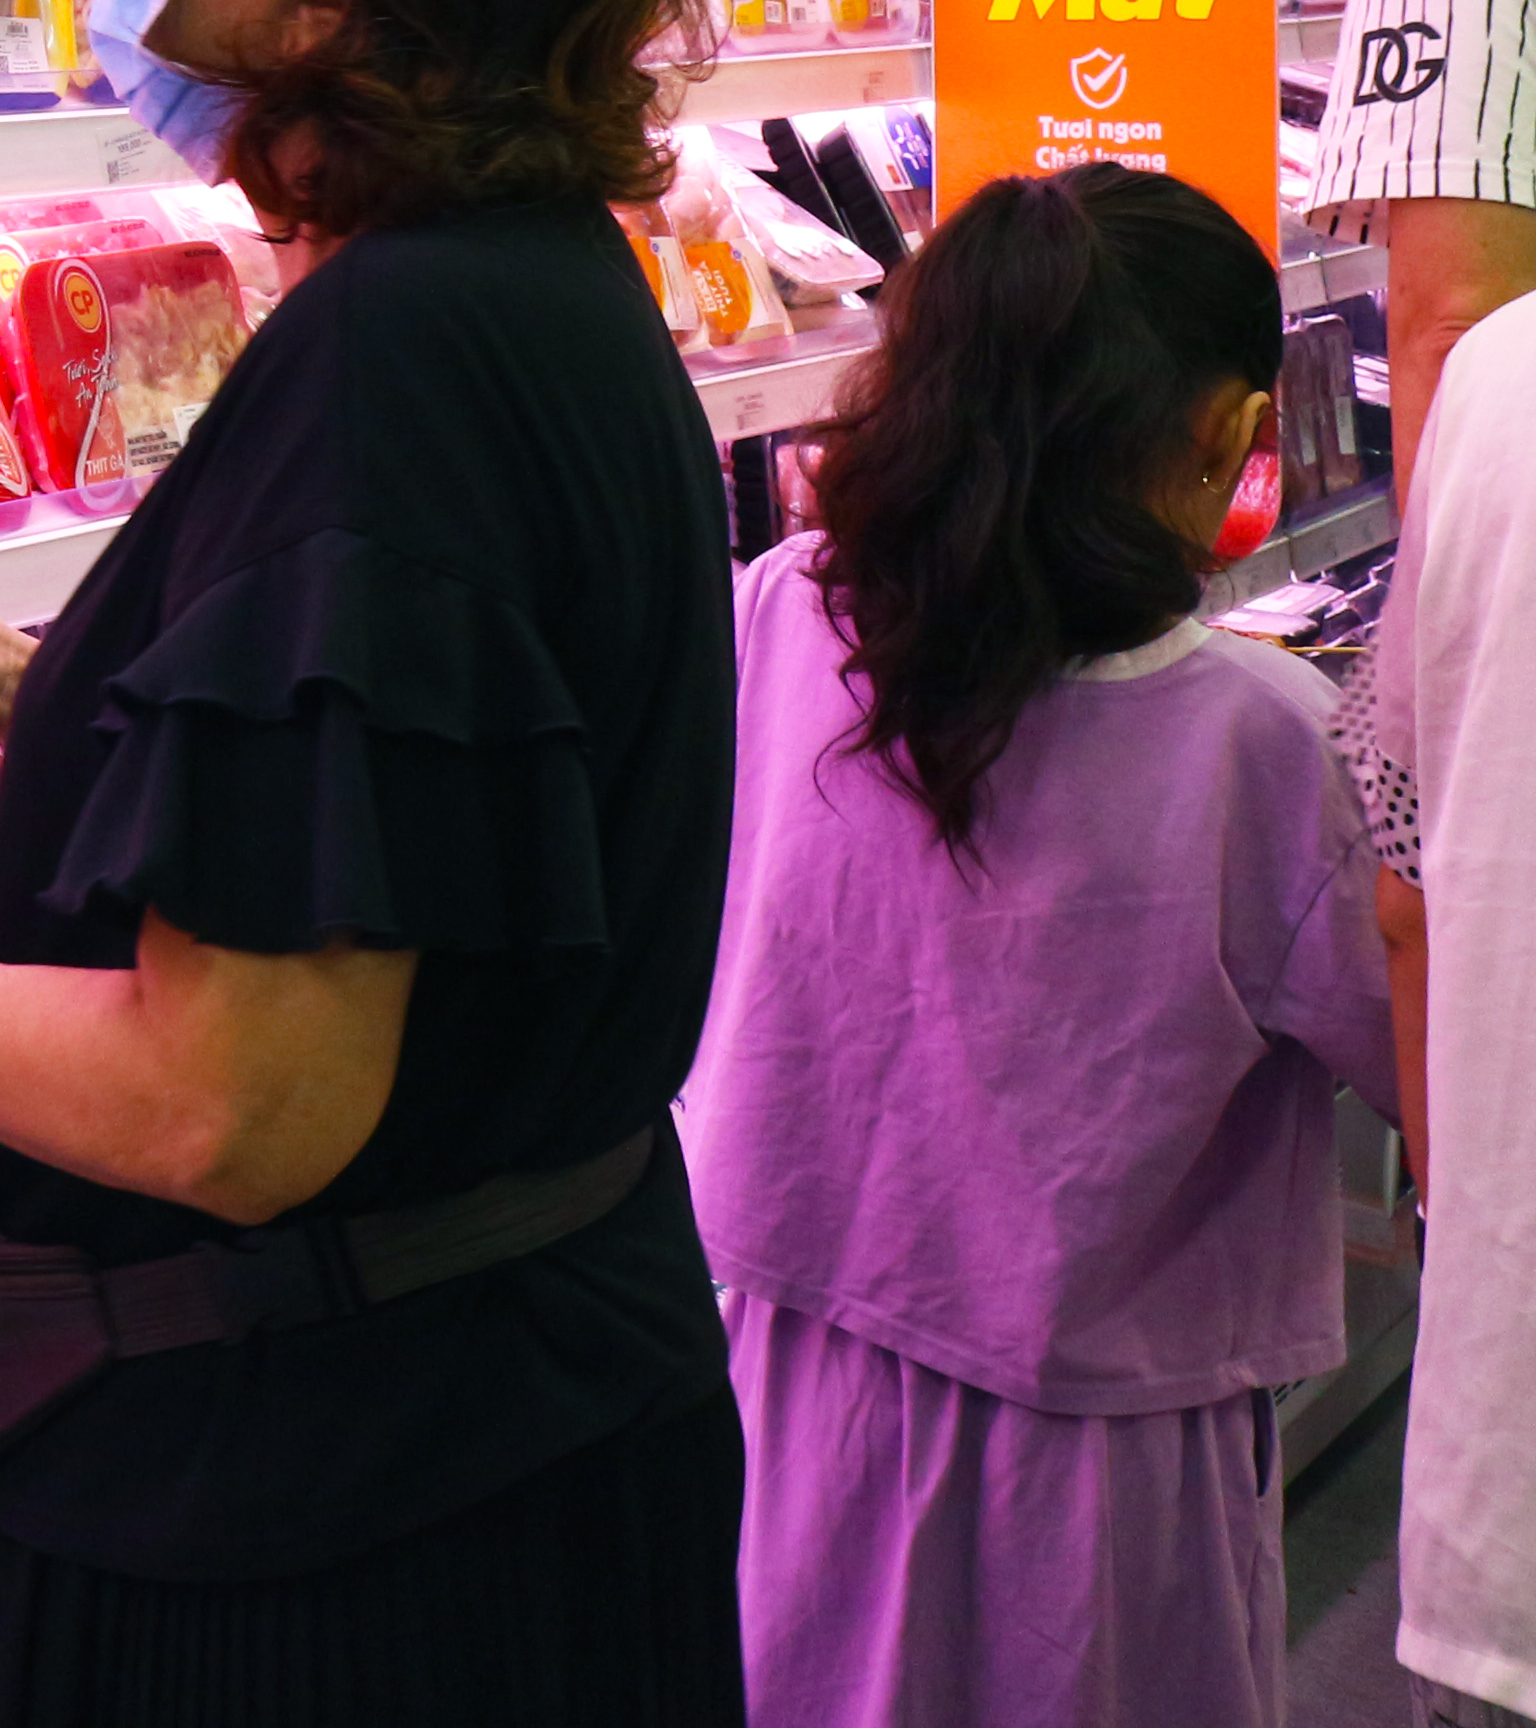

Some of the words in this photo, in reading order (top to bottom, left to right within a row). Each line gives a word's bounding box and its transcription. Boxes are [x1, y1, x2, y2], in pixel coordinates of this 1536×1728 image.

[1037, 115, 1093, 140] Tươi
[1096, 118, 1164, 146] ngon
[71, 293, 95, 316] CP
